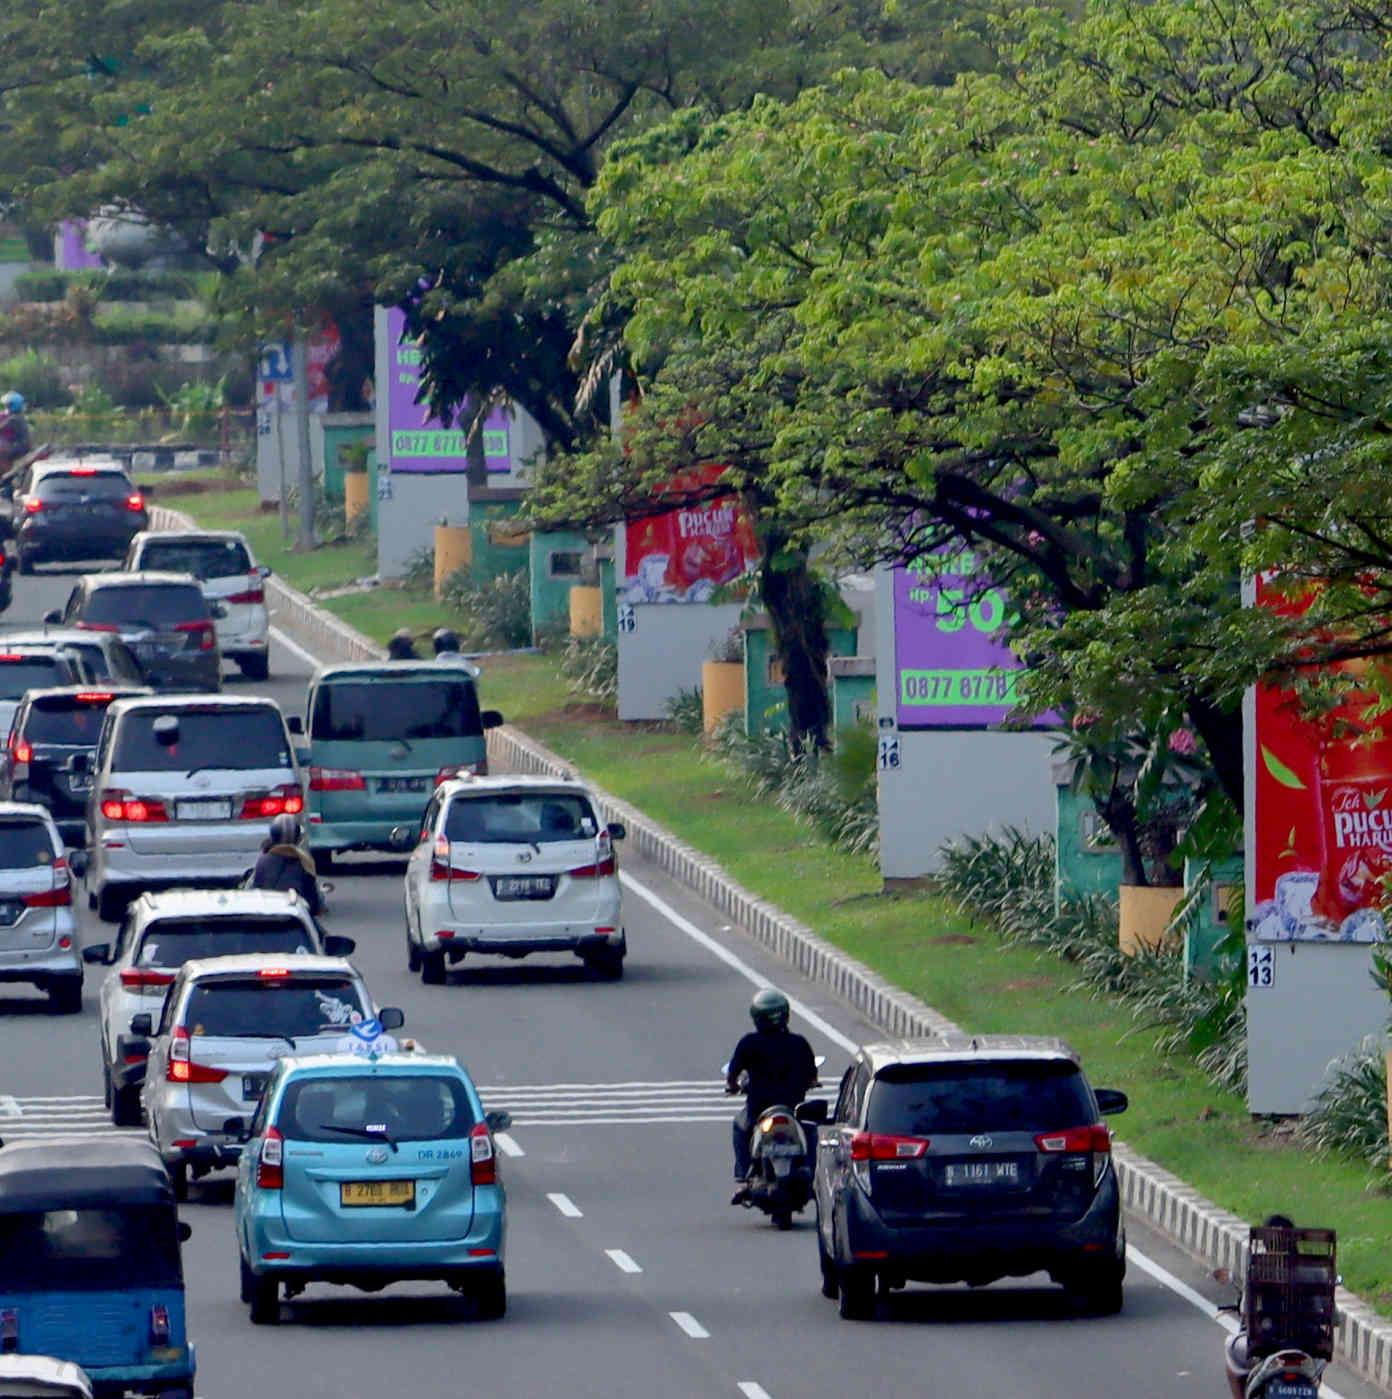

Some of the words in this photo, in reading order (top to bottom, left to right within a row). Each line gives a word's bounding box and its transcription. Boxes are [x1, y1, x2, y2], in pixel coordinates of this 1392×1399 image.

[618, 617, 635, 632] 19
[905, 675, 953, 699] 0877
[880, 752, 900, 768] 16
[1249, 965, 1272, 985] 13
